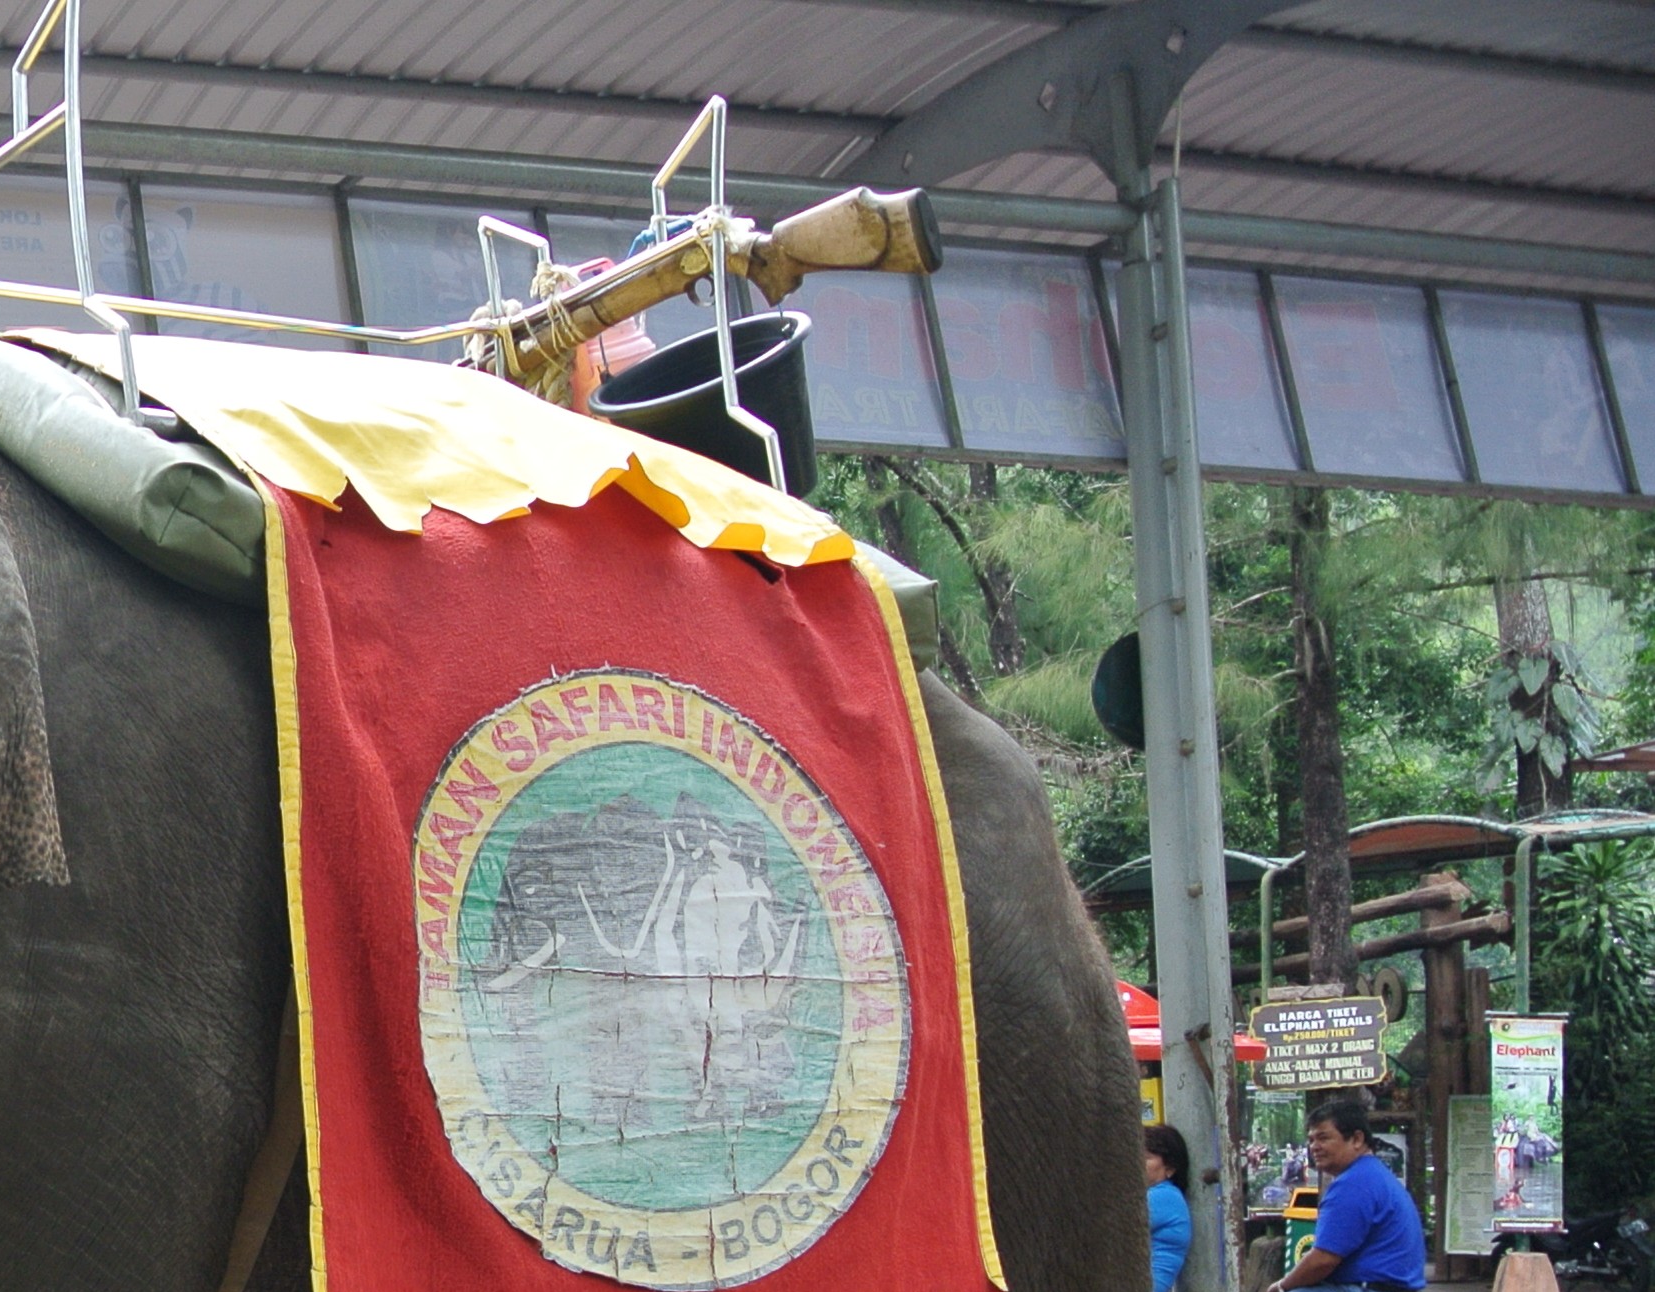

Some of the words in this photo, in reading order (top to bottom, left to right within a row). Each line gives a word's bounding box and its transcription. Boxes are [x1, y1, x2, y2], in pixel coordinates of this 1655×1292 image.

[419, 757, 502, 1003] TAMAN
[491, 682, 687, 774] SAFARI
[700, 708, 897, 1033] INDONESIA
[1326, 1006, 1359, 1019] TIKET
[1263, 1019, 1326, 1033] ELEPHANT
[1333, 1015, 1374, 1028] TRAILS
[1273, 1045, 1301, 1058] TIKET
[1331, 1042, 1339, 1054] 2
[1342, 1038, 1375, 1053] ORANG
[1496, 1044, 1556, 1058] Elephant
[1264, 1058, 1321, 1073] ANAK-ANAK
[1325, 1055, 1364, 1069] MINIMAL
[1265, 1073, 1295, 1086] TINGGI
[1299, 1070, 1332, 1083] BADAN
[1342, 1066, 1375, 1080] METER
[457, 1108, 658, 1274] CISARUA
[718, 1122, 865, 1264] BOGOR
